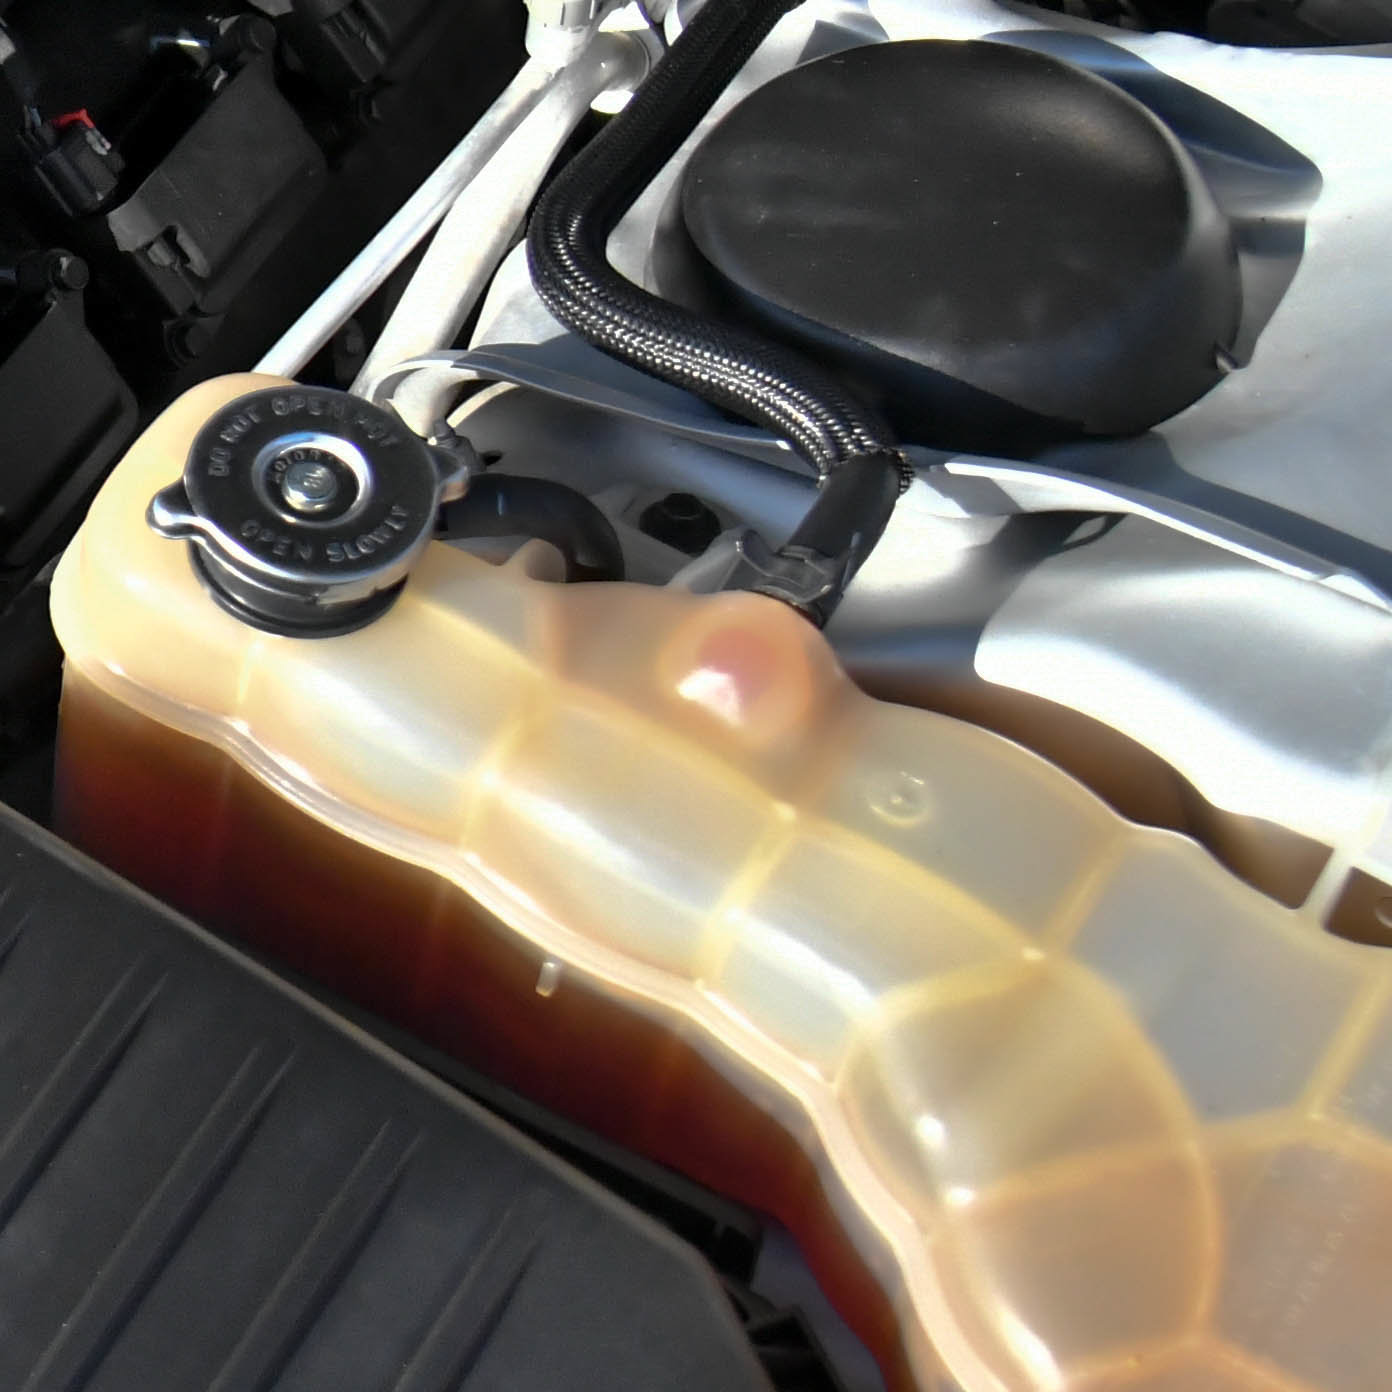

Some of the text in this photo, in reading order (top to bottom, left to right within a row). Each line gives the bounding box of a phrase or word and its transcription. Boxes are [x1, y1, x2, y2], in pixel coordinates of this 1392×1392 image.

[271, 393, 347, 417] OPEN
[219, 406, 262, 445] NOT
[208, 447, 232, 477] DO
[240, 504, 408, 563] OPEN SLOWLY
